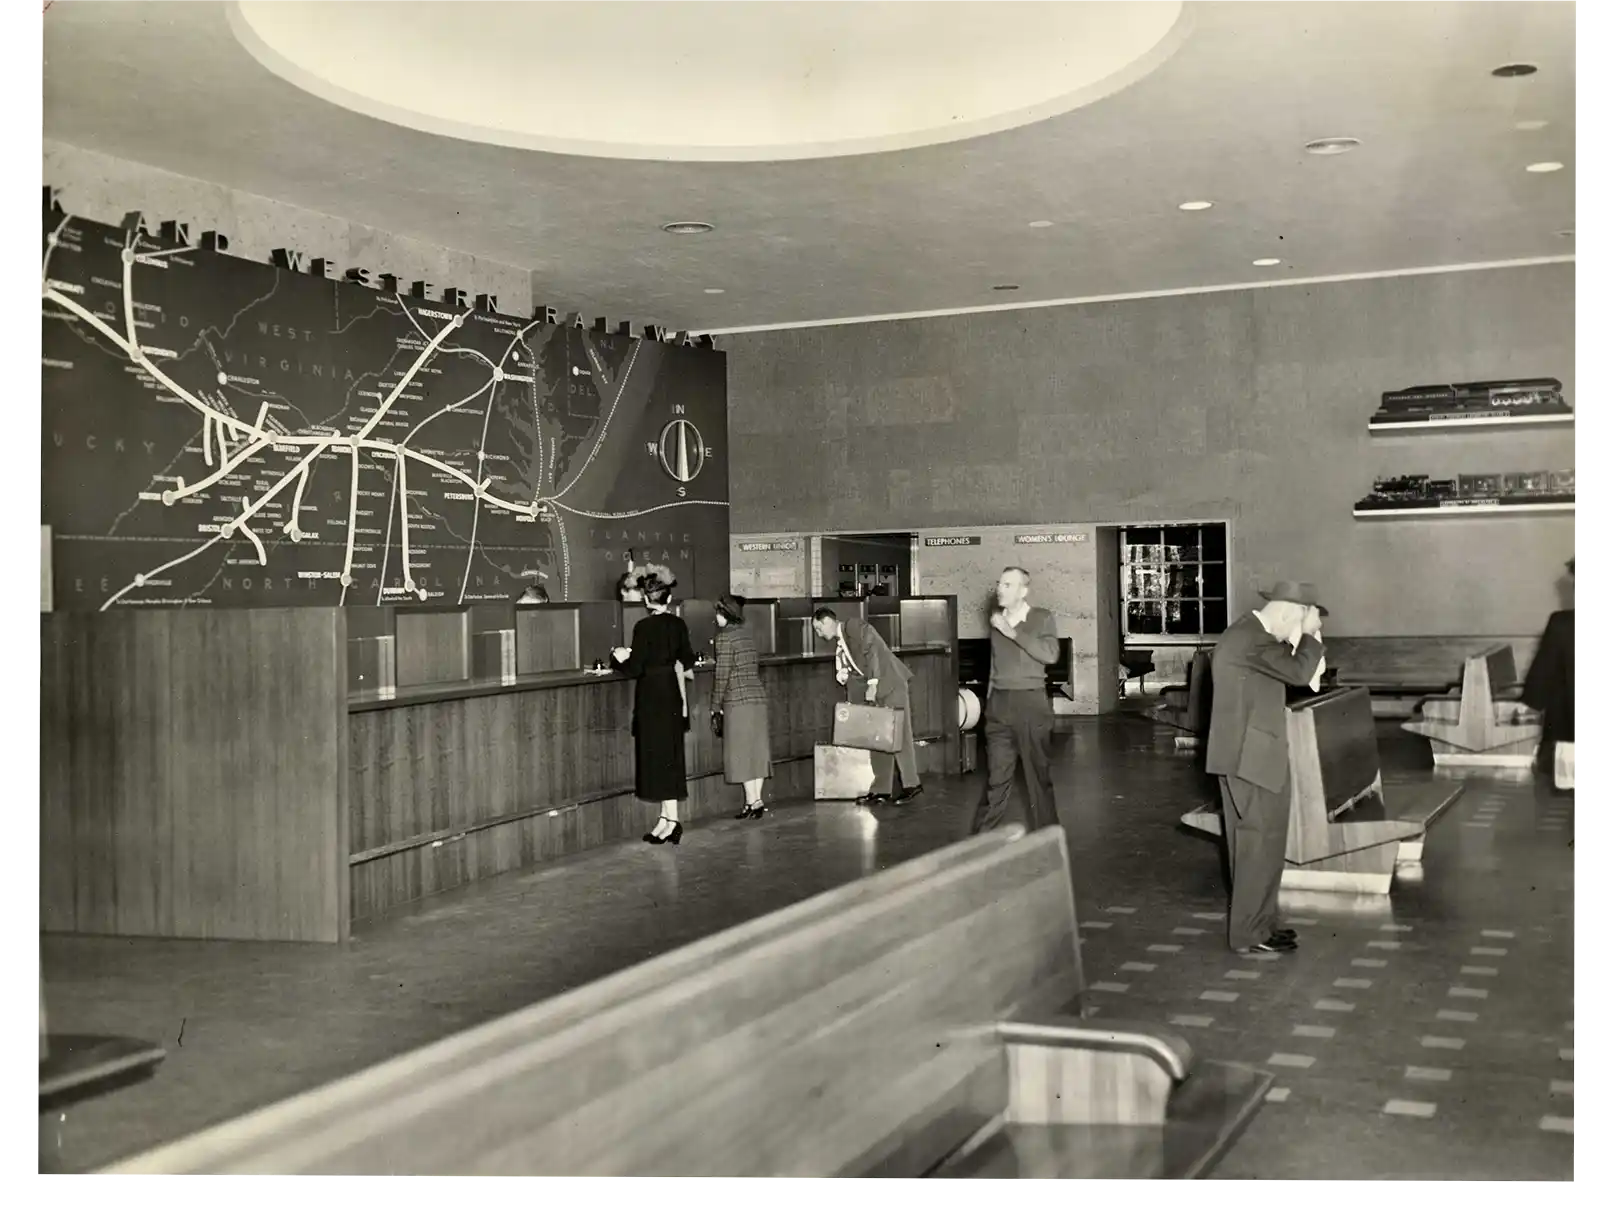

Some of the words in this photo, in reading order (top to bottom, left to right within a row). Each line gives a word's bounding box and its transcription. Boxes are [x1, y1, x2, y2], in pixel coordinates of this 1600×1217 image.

[127, 211, 229, 252] AND
[275, 248, 498, 314] WESTERN
[539, 305, 718, 351] RAILWAY
[258, 321, 313, 342] WEST
[224, 350, 354, 381] VIRGINIA
[586, 529, 691, 543] TLANTIC
[926, 537, 970, 546] TELEPHONES
[1054, 533, 1086, 543] LOUNGE
[222, 578, 317, 590] NORTH
